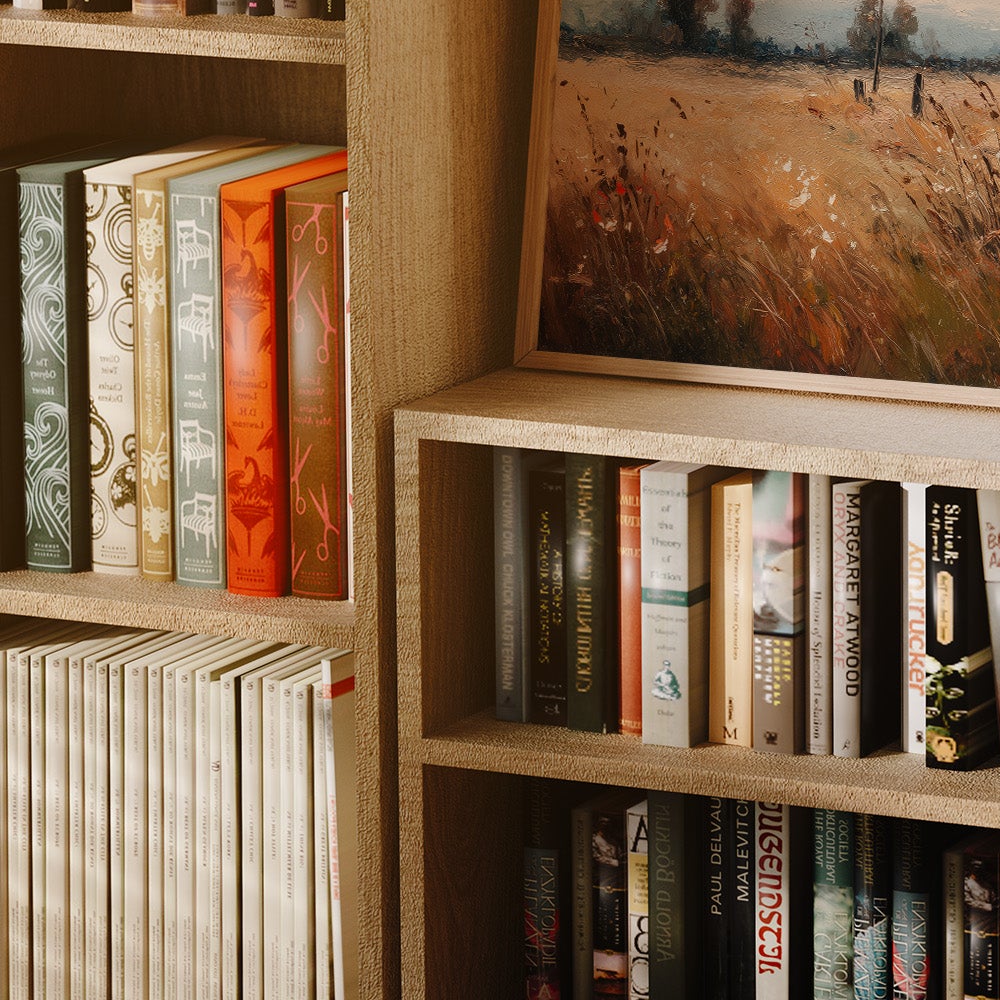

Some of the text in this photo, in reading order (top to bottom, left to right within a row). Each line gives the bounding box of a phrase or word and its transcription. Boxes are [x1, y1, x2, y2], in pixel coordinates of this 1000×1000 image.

[500, 455, 515, 690] DOWNTOWN OWL CHUCK KLOSTERMAN
[651, 537, 682, 550] Theory
[833, 492, 845, 669] ORYX AND CRAKE
[845, 493, 860, 697] MARGARET ATWOOD
[722, 726, 738, 741] M
[710, 797, 722, 916] PAUL DELVAU
